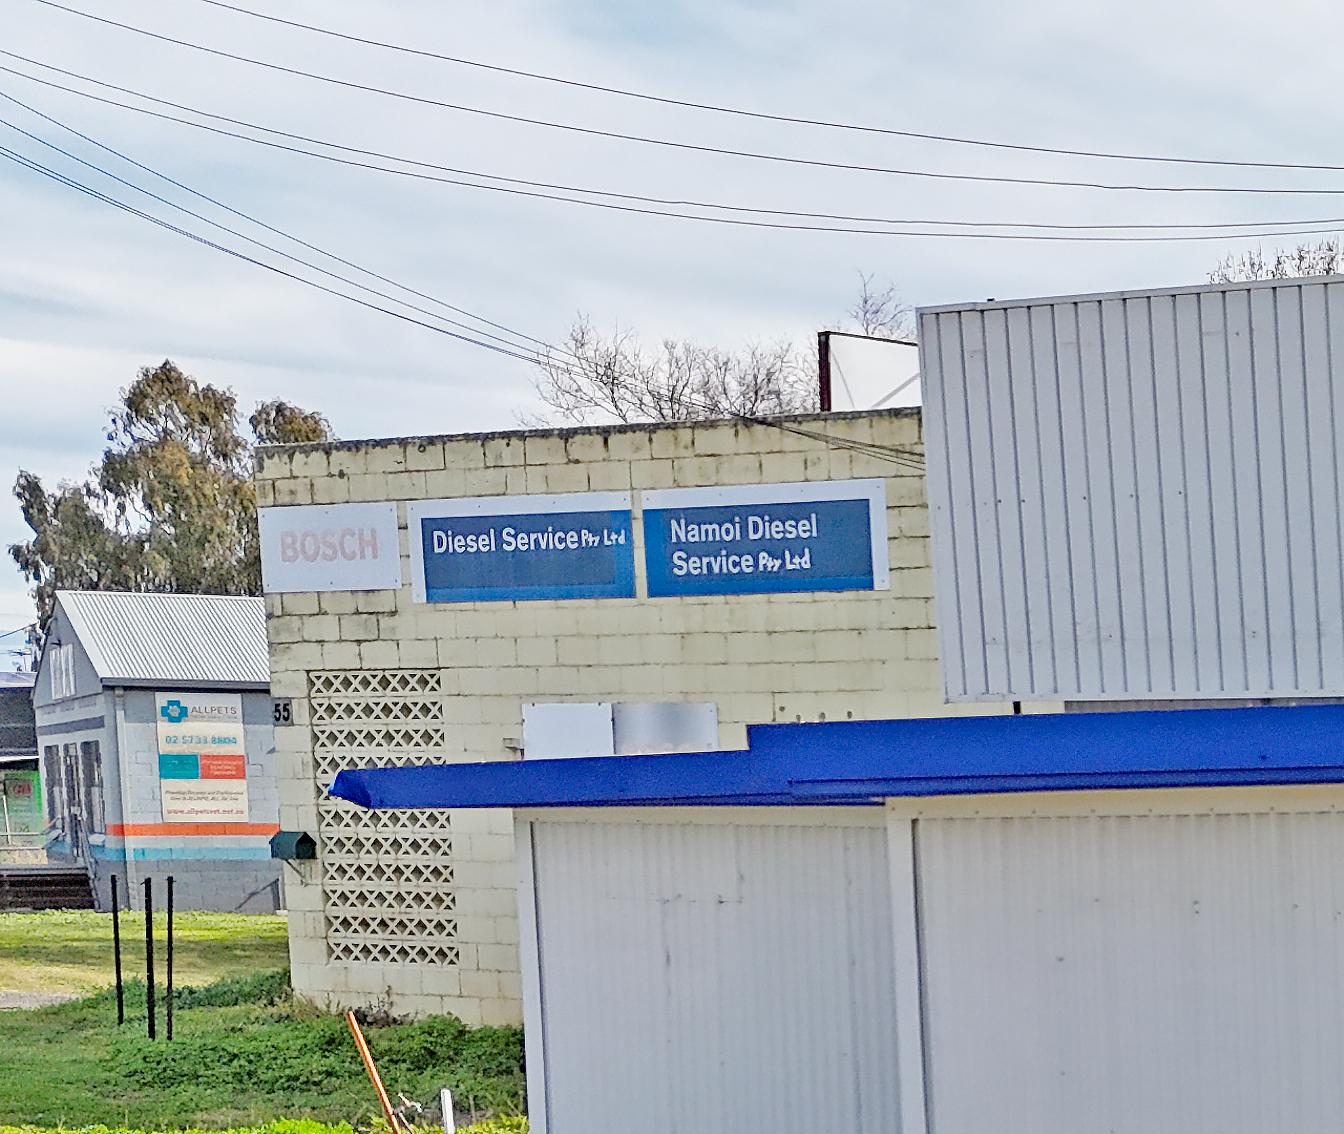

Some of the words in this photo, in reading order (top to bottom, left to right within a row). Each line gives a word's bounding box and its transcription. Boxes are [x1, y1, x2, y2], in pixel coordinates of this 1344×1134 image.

[433, 529, 496, 554] Diesel
[502, 526, 580, 552] Service
[581, 532, 600, 549] Pty
[603, 529, 626, 546] Ltd
[670, 517, 741, 543] Namoi
[748, 513, 818, 540] Diesel
[280, 527, 379, 564] BOSCH
[672, 550, 754, 576] Service
[758, 552, 782, 572] Pty
[785, 547, 811, 570] Ltd
[191, 706, 237, 715] ALLPETS
[274, 703, 289, 721] 55
